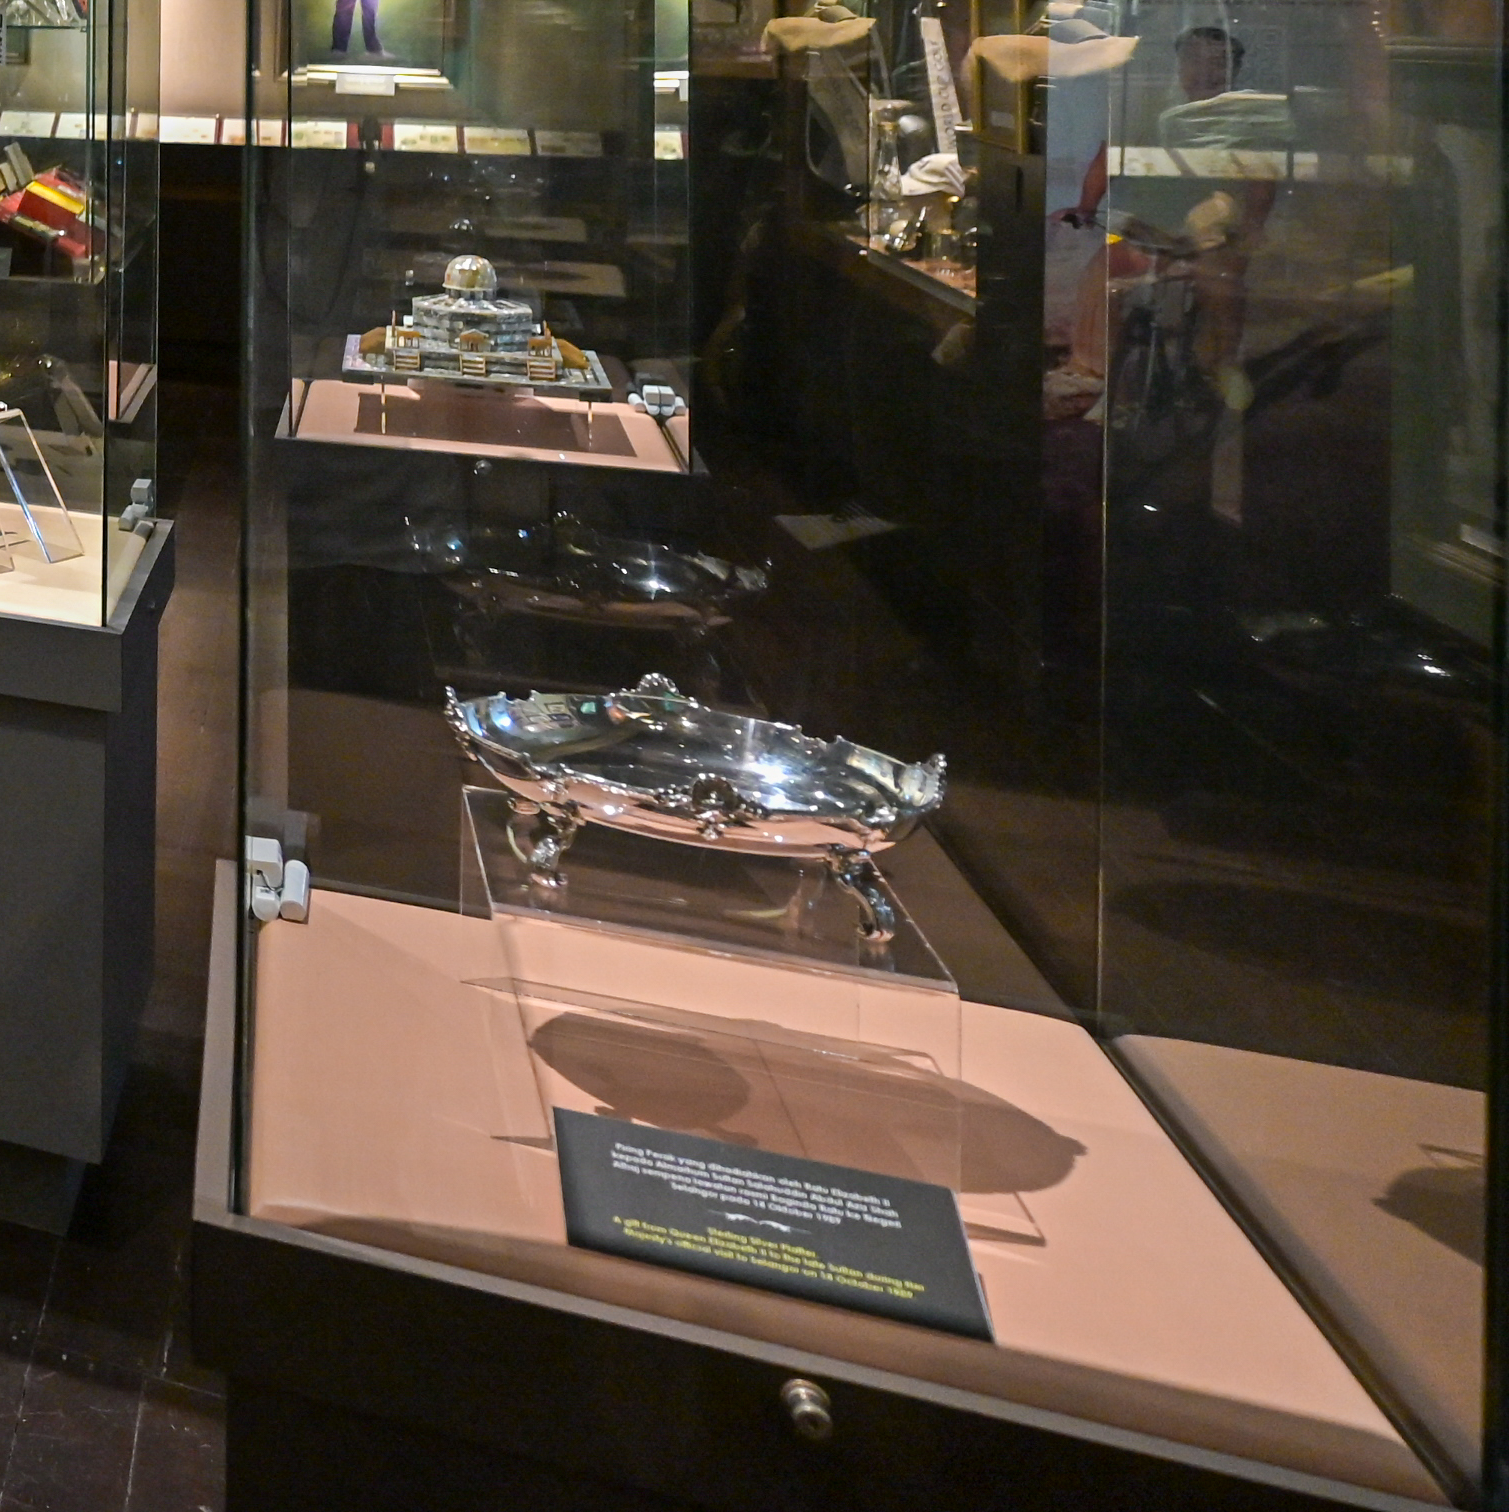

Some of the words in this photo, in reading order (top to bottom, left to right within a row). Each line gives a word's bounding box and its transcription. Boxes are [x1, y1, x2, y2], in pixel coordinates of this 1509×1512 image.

[678, 1157, 706, 1170] yang
[613, 1215, 622, 1224] A
[669, 1227, 707, 1243] Queen
